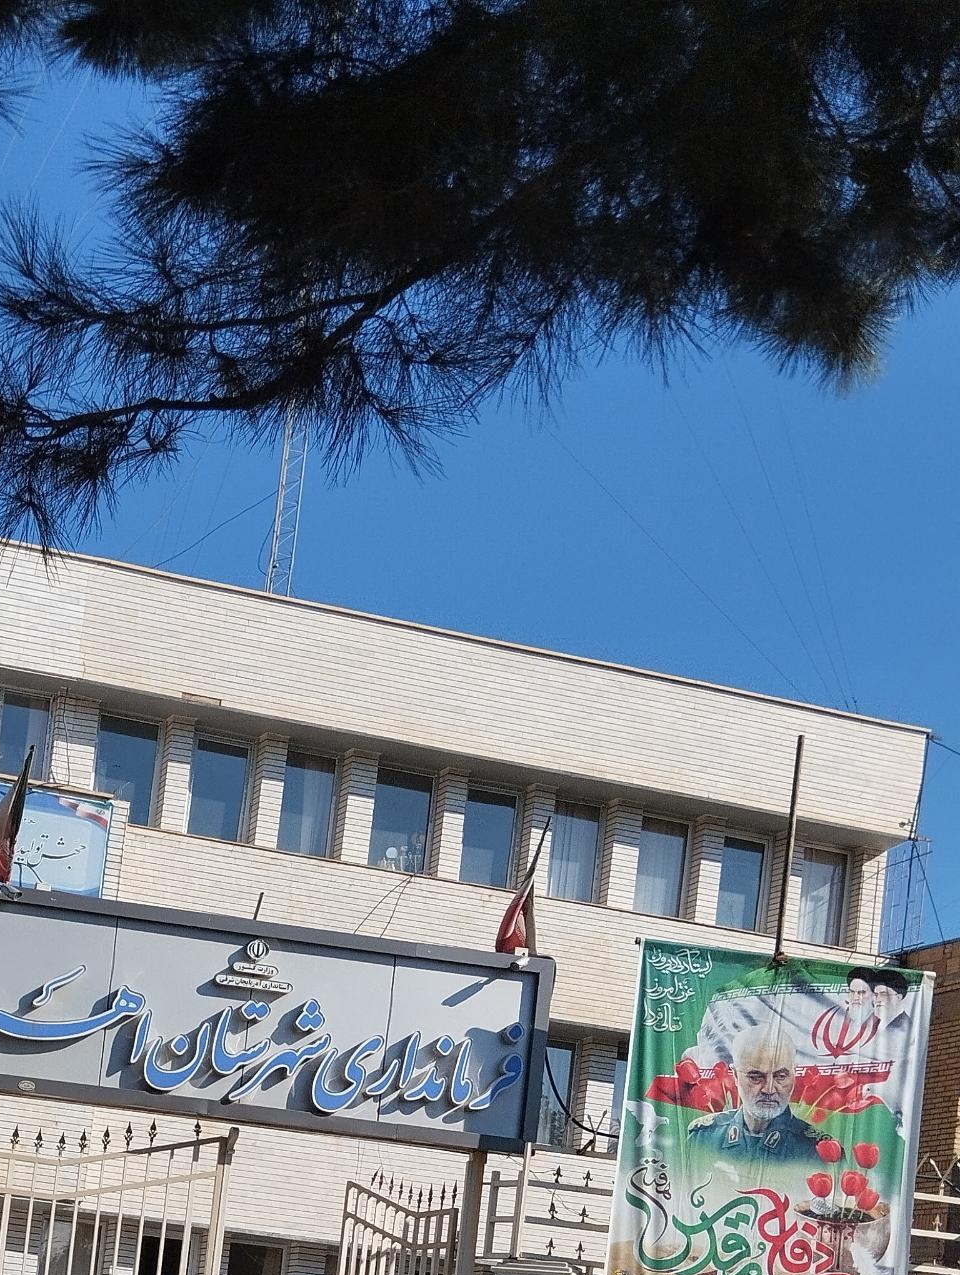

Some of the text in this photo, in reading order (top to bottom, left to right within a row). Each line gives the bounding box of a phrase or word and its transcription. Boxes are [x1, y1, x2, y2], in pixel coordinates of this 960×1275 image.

[257, 966, 274, 975] وزارت
[261, 981, 290, 991] استانداری
[142, 996, 332, 1101] شهرستان
[313, 1020, 527, 1114] فرمانداری
